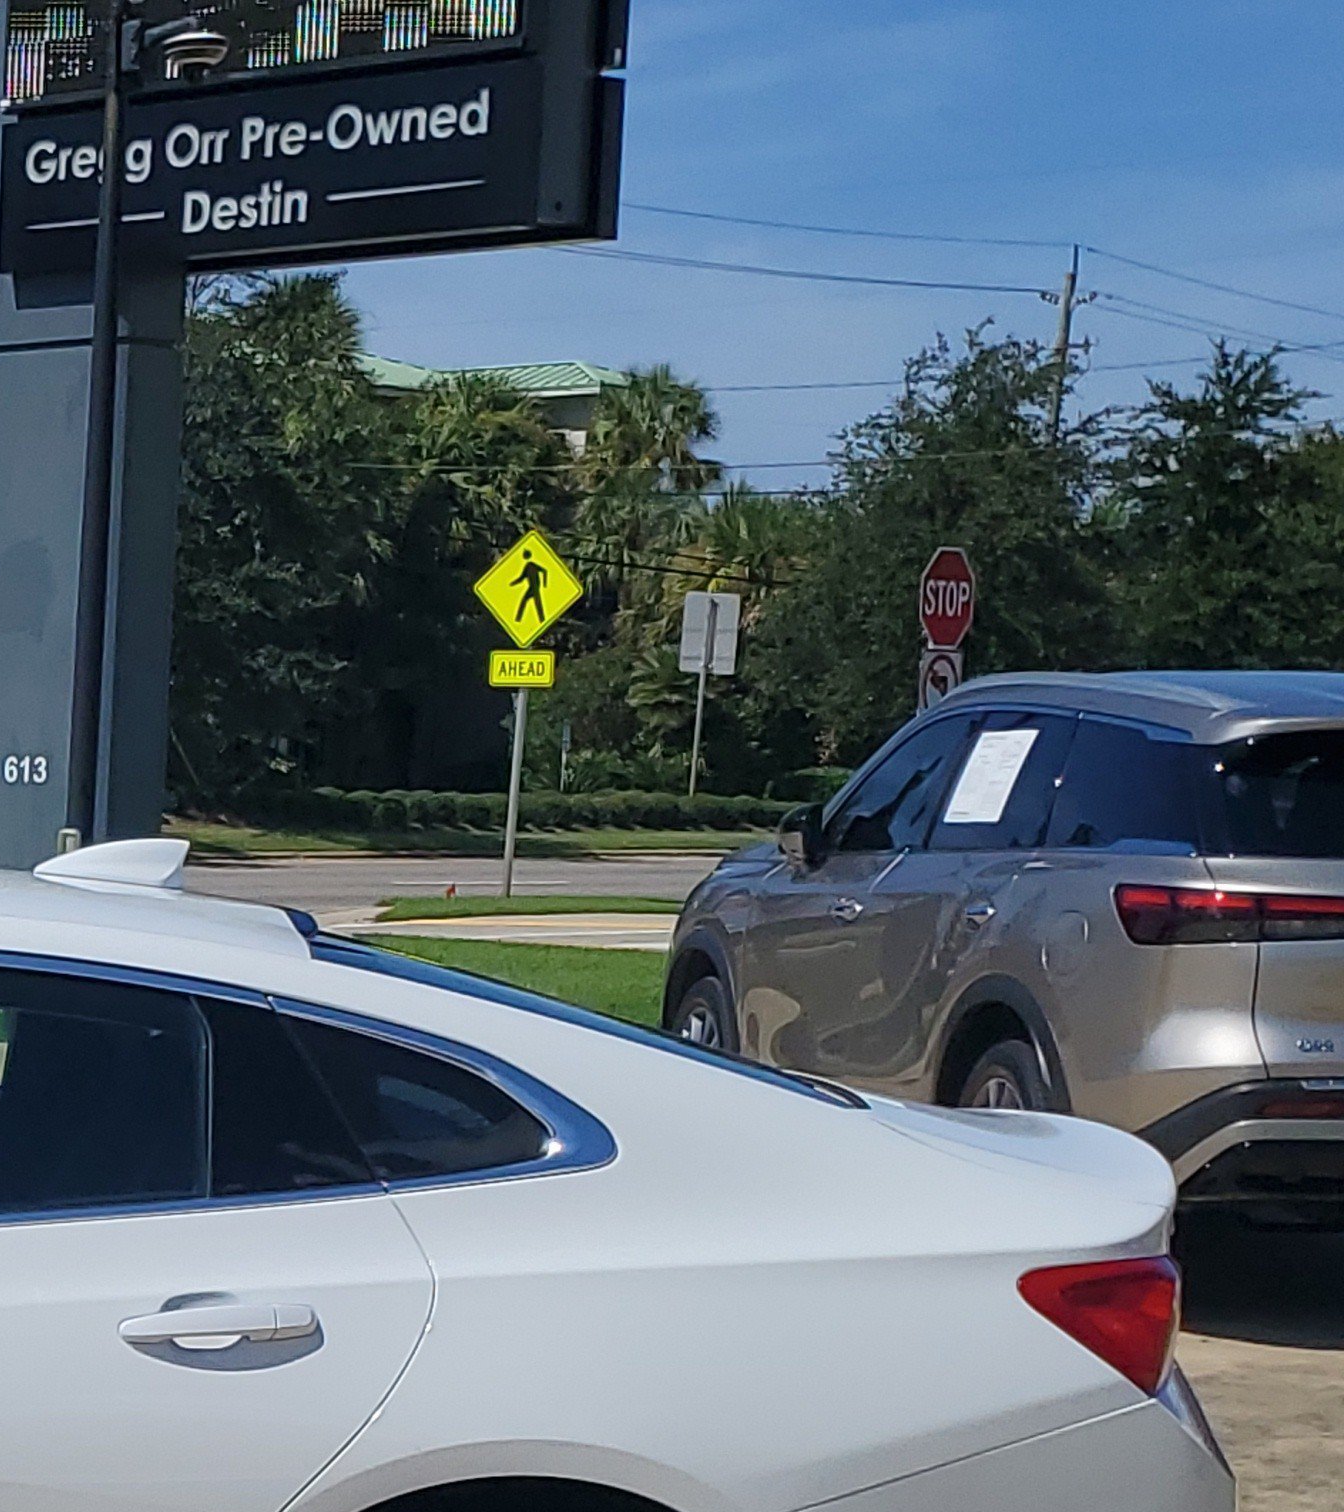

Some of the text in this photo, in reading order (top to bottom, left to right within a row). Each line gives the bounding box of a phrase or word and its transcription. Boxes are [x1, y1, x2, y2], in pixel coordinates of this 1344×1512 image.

[165, 122, 230, 169] Orr
[240, 87, 491, 161] Pre-Owned
[182, 180, 309, 234] Destin
[924, 579, 970, 617] STOP
[498, 661, 546, 677] AHEAD
[4, 755, 48, 784] 613
